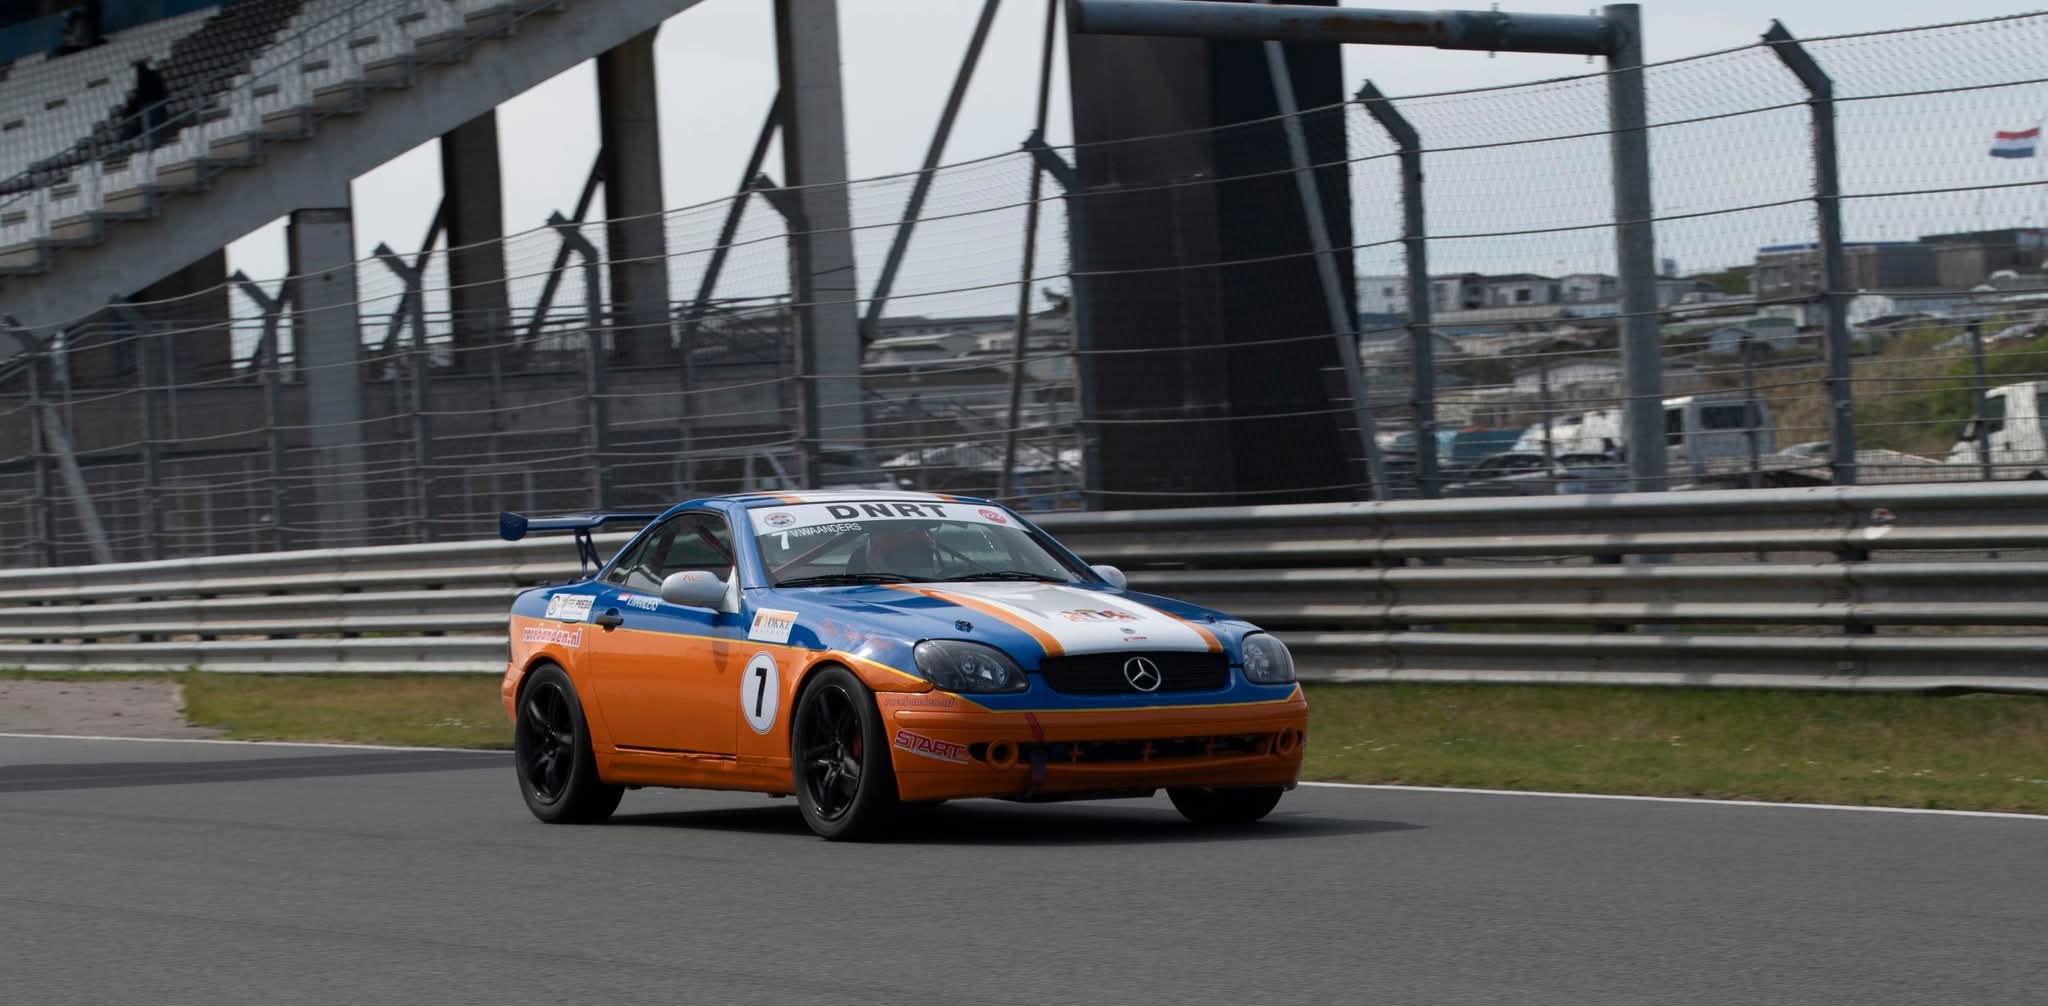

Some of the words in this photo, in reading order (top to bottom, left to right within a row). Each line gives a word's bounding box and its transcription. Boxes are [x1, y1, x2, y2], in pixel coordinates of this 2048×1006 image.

[826, 503, 948, 520] DNRT
[771, 531, 790, 551] 7
[755, 667, 767, 717] 7
[894, 730, 968, 759] START
